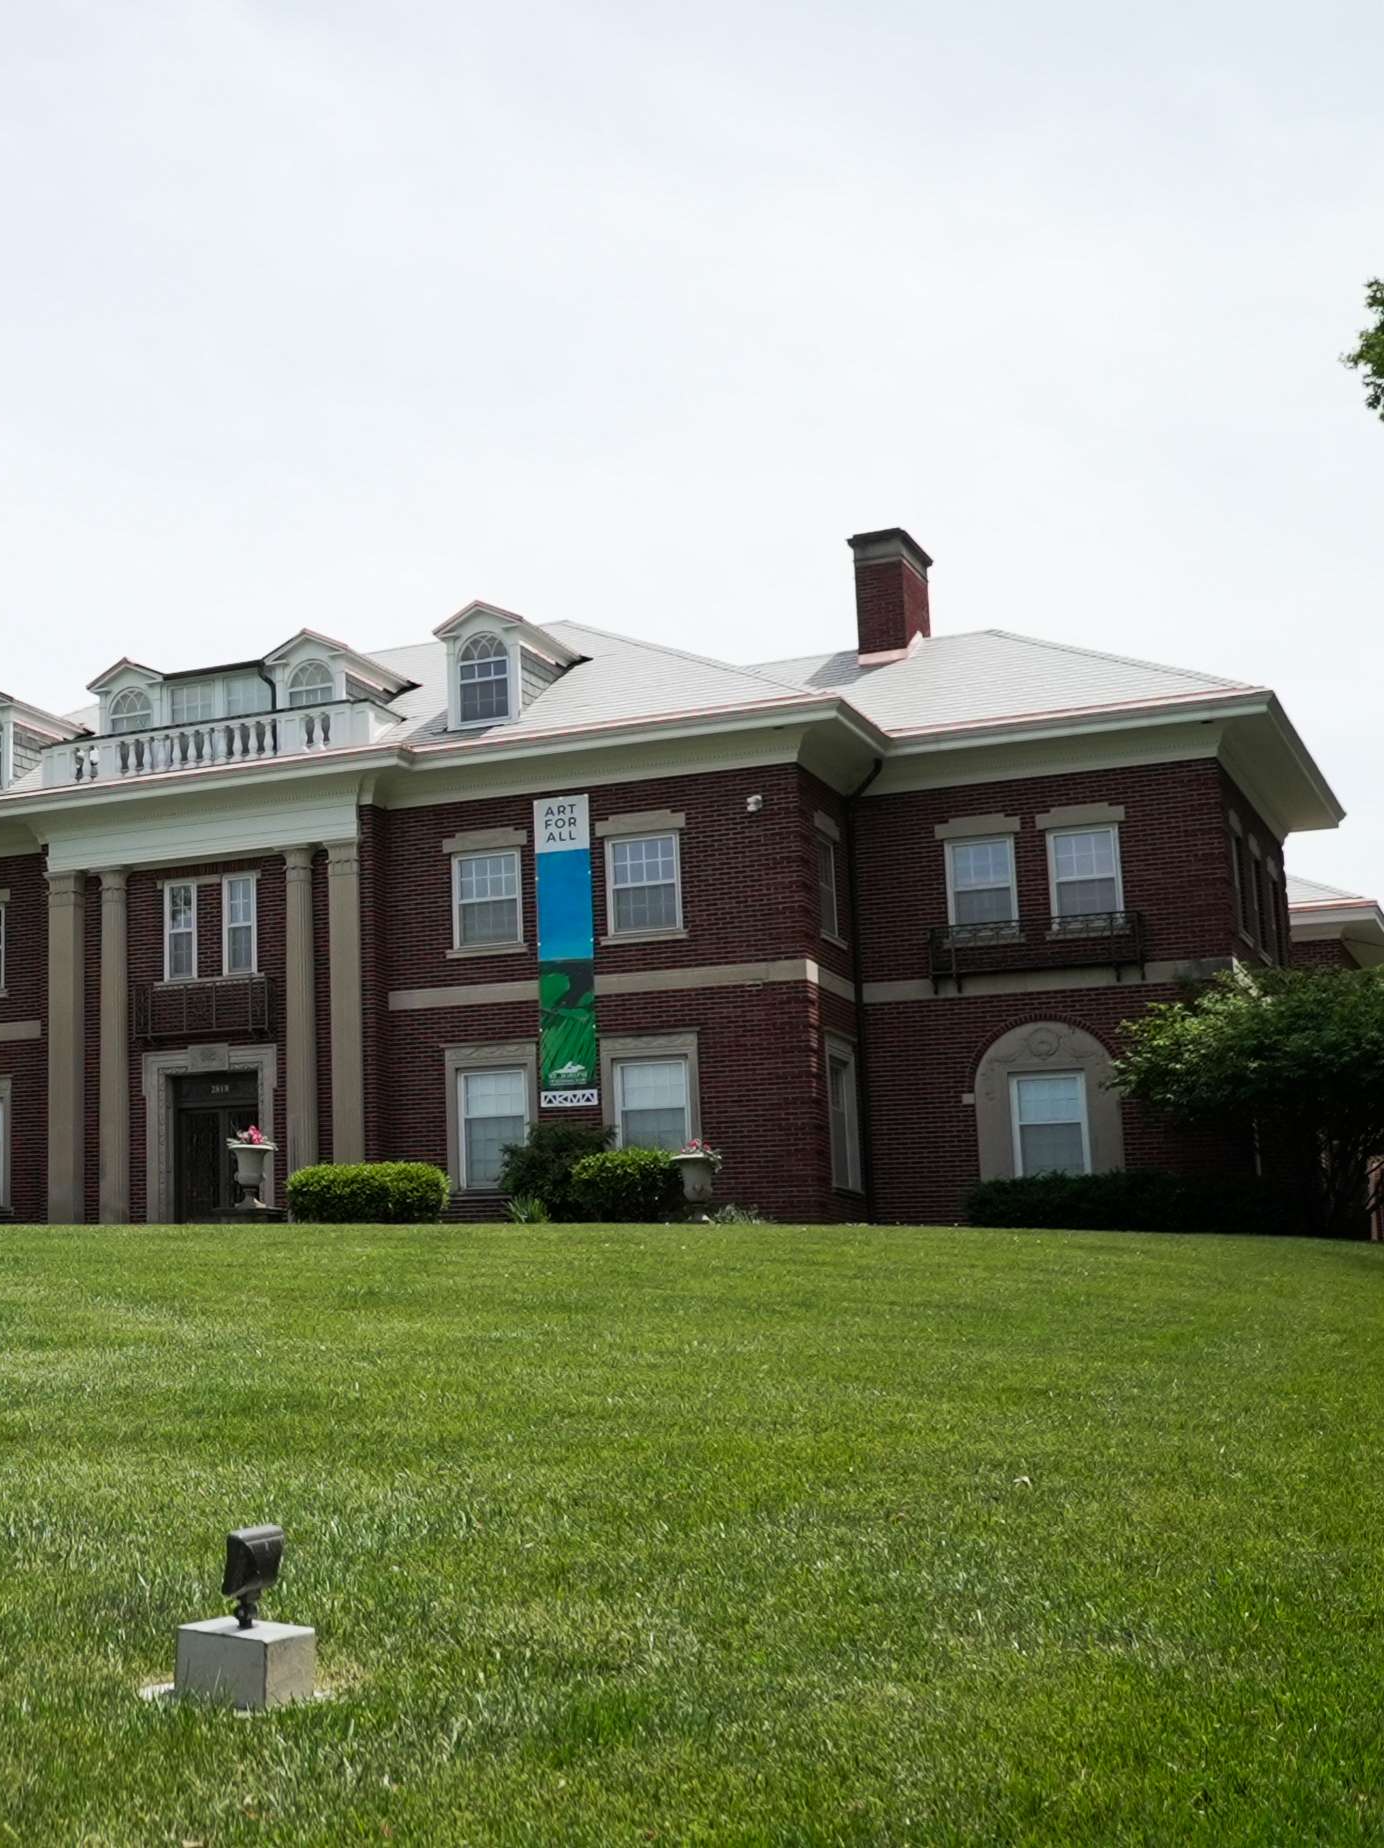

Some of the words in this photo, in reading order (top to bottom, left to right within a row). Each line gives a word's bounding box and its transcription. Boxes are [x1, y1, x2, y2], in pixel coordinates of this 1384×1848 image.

[544, 803, 576, 817] ART
[544, 816, 576, 830] FOR
[546, 830, 576, 843] ALL
[543, 1092, 596, 1105] AKMA
